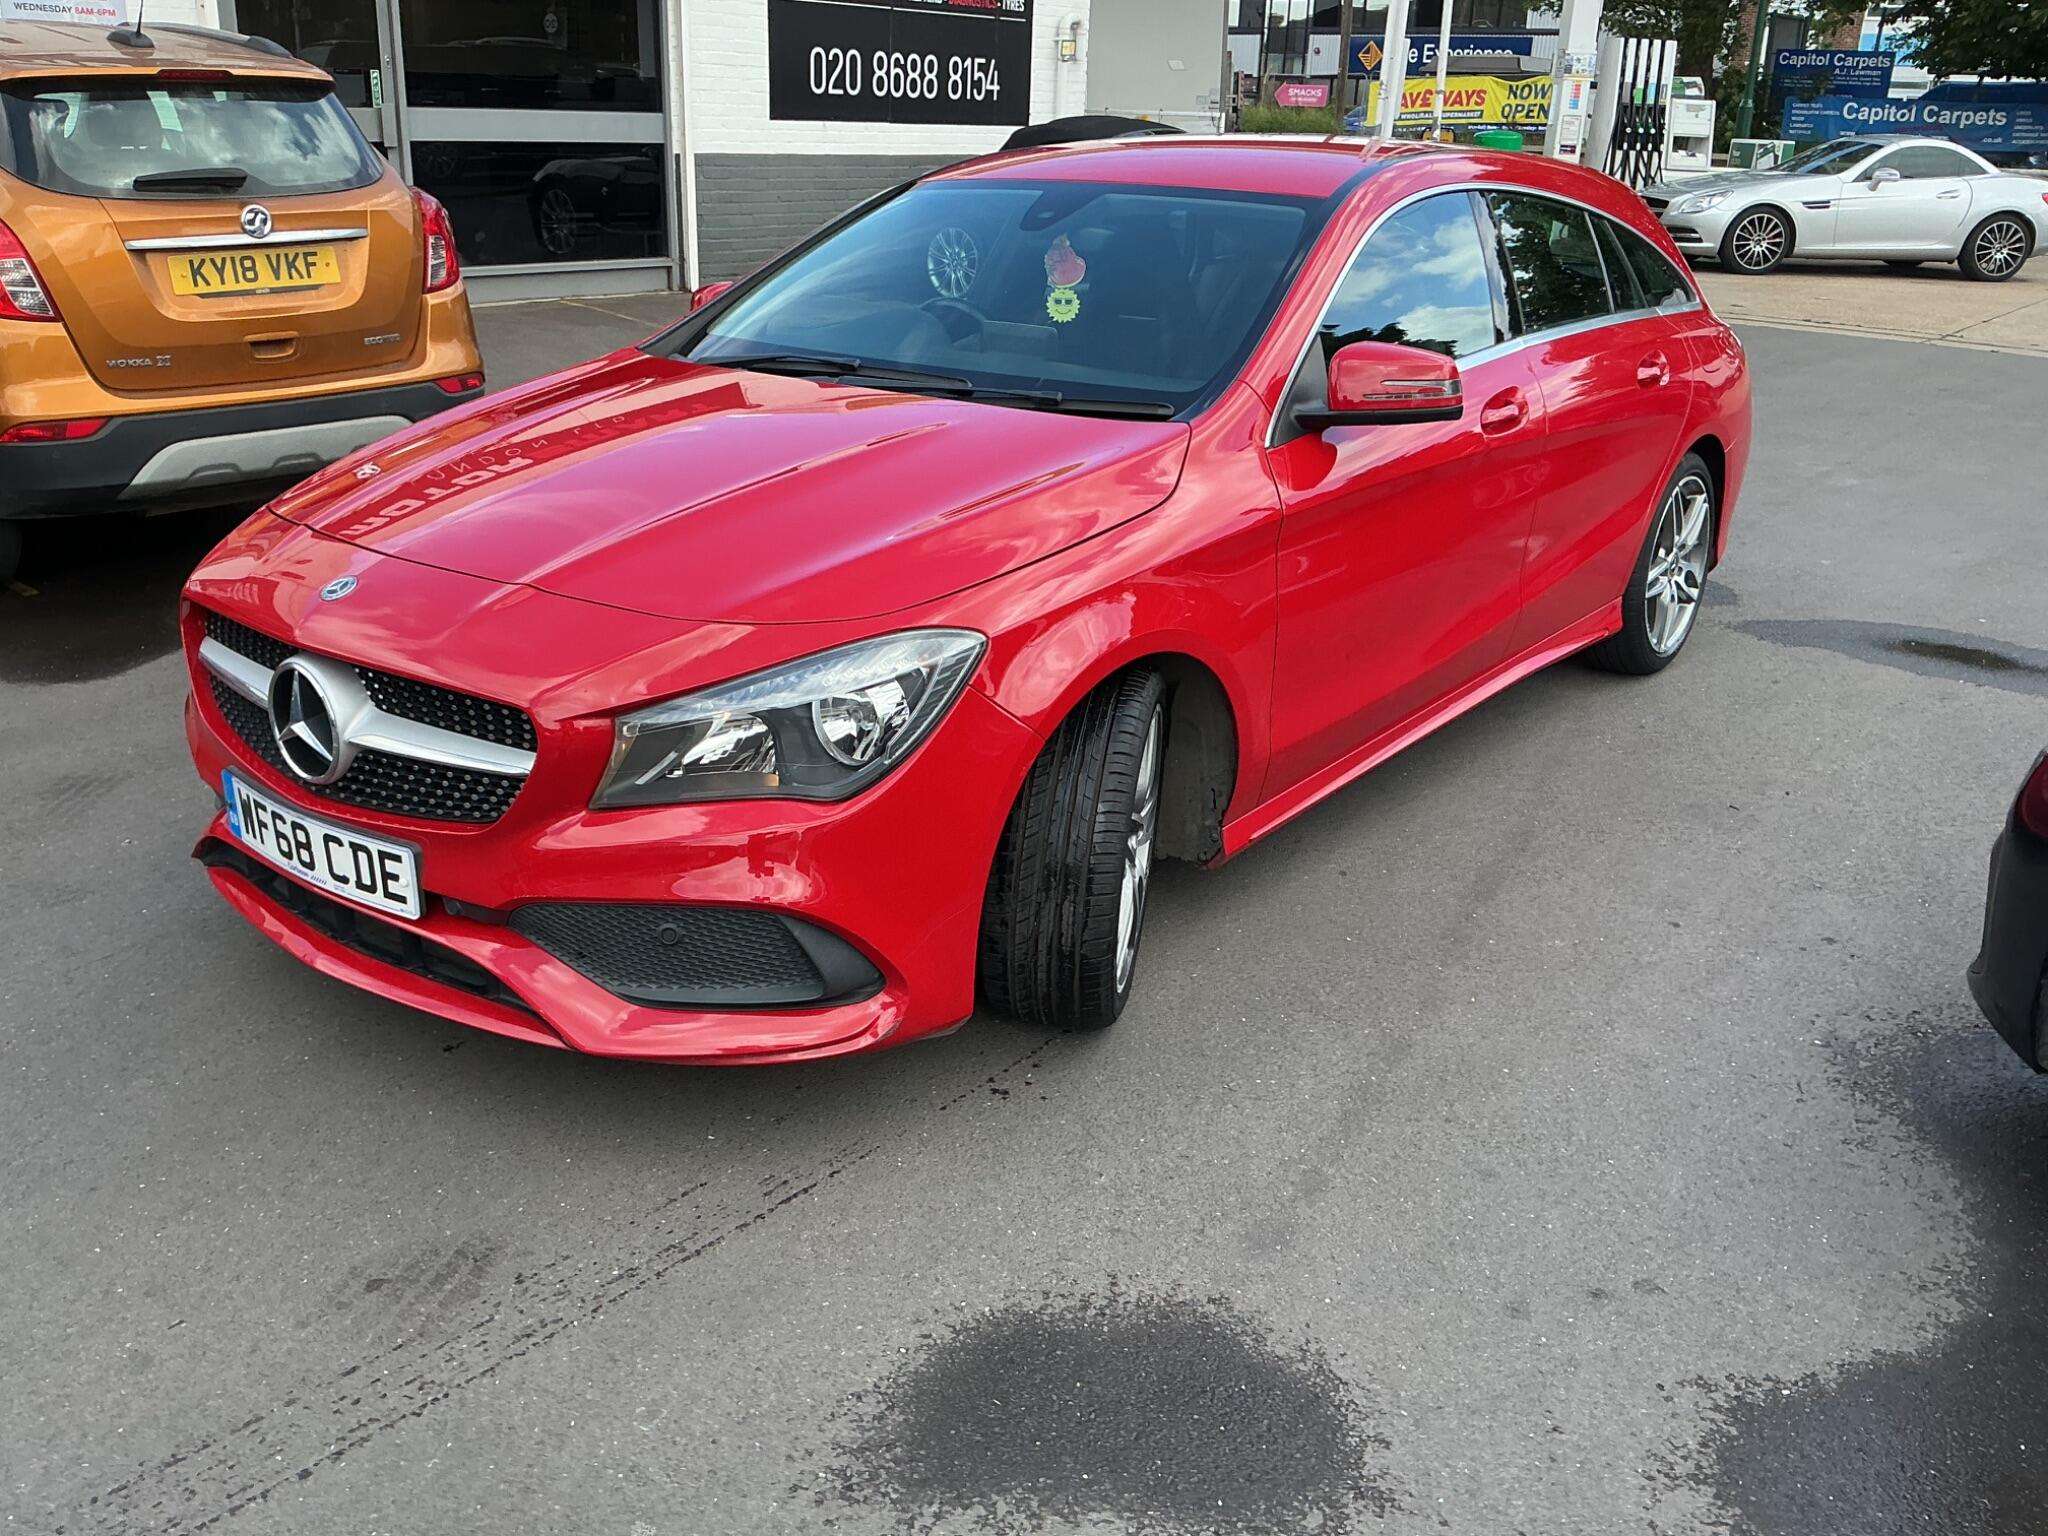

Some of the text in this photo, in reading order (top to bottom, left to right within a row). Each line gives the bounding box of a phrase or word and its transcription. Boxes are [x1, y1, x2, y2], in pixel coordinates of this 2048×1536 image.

[13, 2, 73, 13] WEDNESDAY
[1779, 52, 1891, 70] Capitol Carpets
[810, 46, 1001, 102] 020 8688 8154
[1287, 87, 1323, 97] SMACKS
[1500, 103, 1550, 120] OPEN
[1842, 101, 2007, 129] Capitol Carpets
[188, 251, 318, 288] KY18 VKF
[322, 832, 408, 905] CDE
